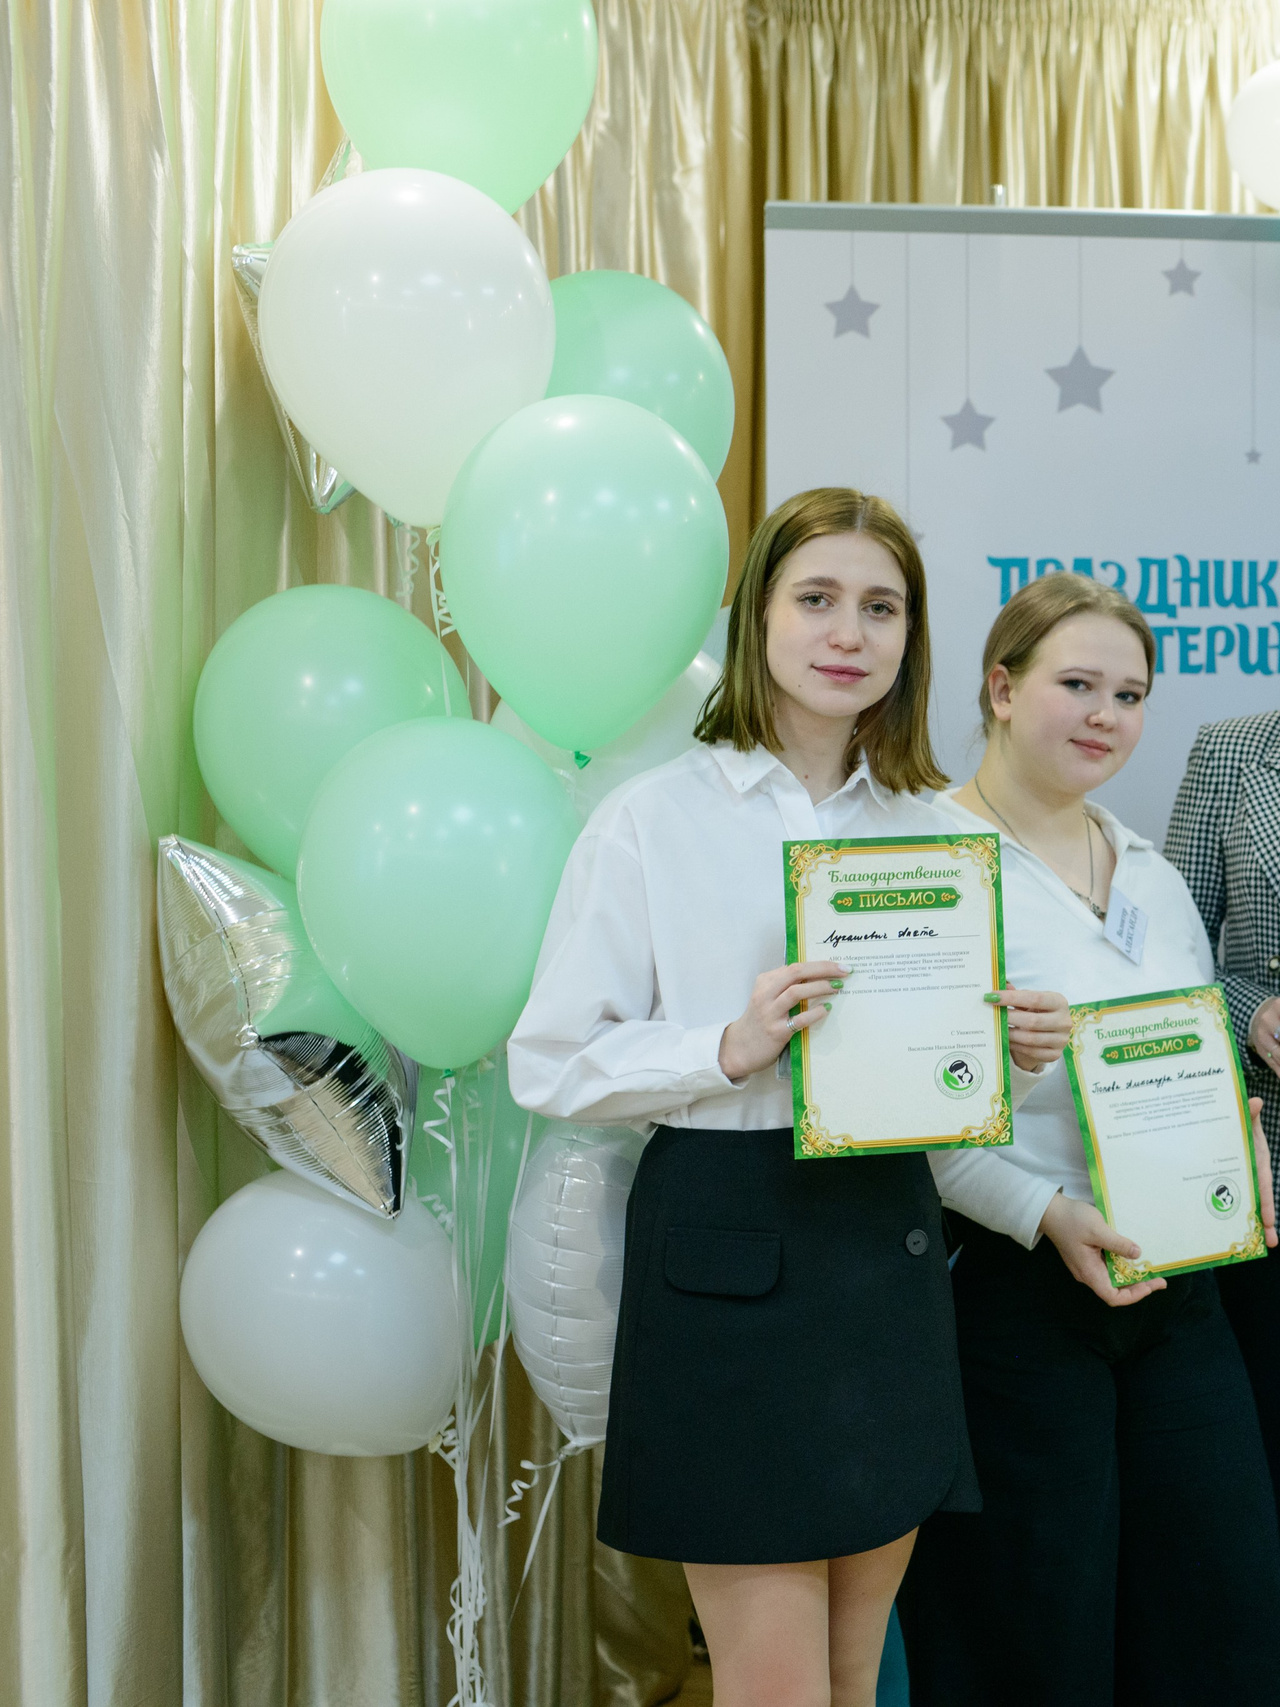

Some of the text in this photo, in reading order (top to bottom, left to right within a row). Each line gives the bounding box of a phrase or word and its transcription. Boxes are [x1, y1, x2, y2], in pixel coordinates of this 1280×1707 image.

[987, 554, 1279, 619] ПЗДНИК
[828, 865, 962, 886] Благодарственное
[858, 891, 936, 908] ПИСЬМО
[1094, 1016, 1199, 1040] Благодарственное
[1122, 1038, 1184, 1059] ПИСЬМО
